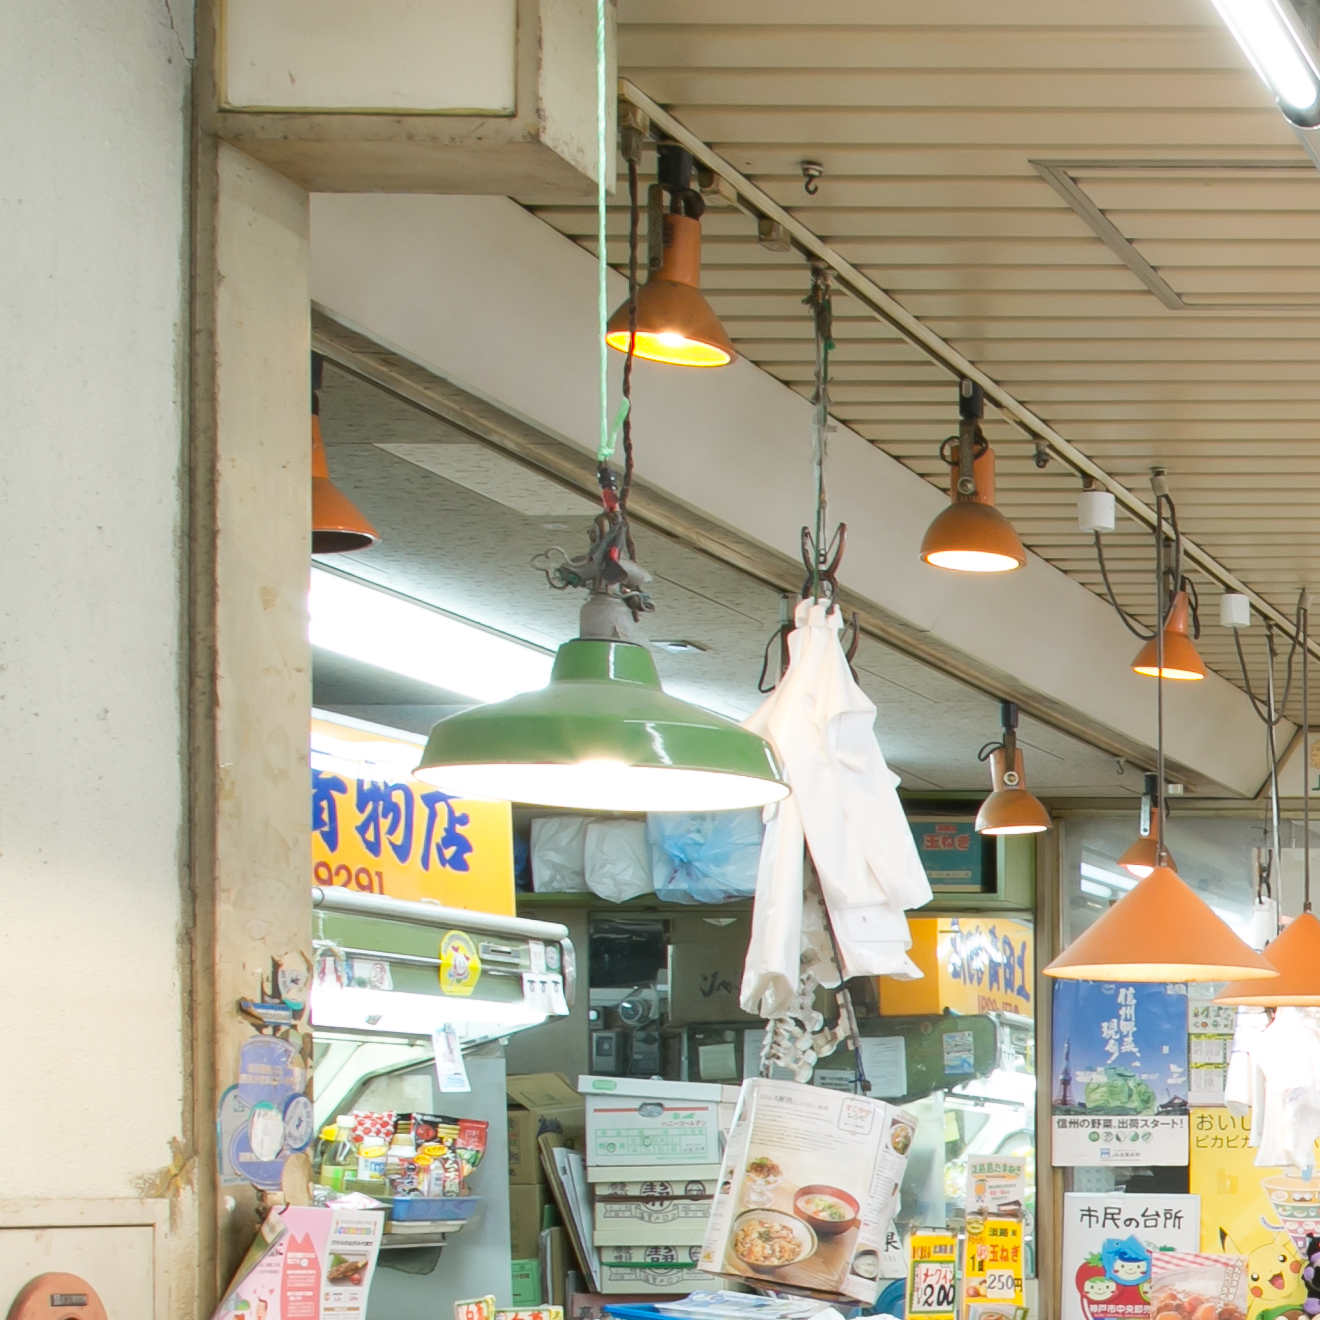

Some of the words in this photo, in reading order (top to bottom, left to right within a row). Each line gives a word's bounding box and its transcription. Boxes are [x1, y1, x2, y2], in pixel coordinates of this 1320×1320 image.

[1079, 1206, 1184, 1230] 市民の台所
[988, 1243, 1021, 1264] 玉ねぎ
[987, 1273, 1023, 1294] 250円
[920, 1283, 957, 1308] 200
